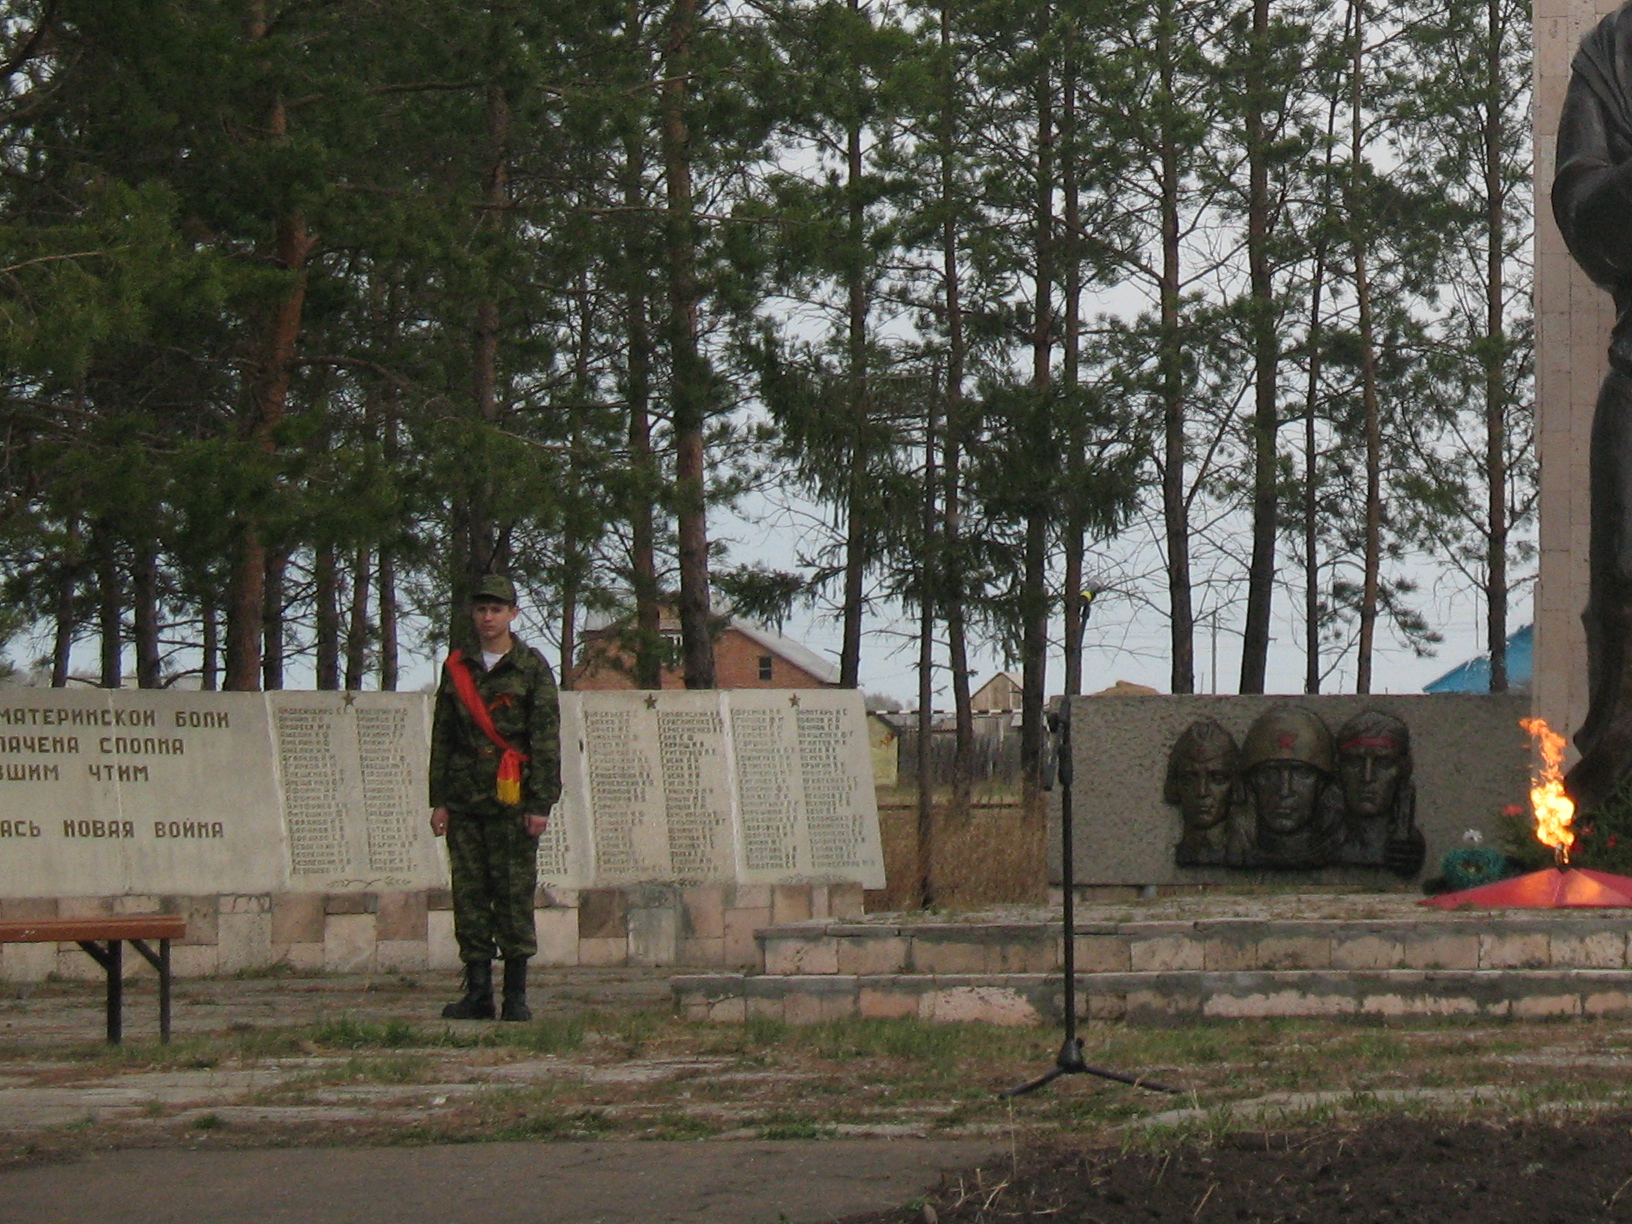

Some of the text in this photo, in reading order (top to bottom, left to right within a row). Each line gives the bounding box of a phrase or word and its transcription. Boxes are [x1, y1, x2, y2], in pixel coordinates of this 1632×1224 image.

[0, 763, 150, 782] ШИМ ЧТИМ
[62, 819, 136, 839] НОВАЯ
[153, 817, 225, 839] ВОЙНА
